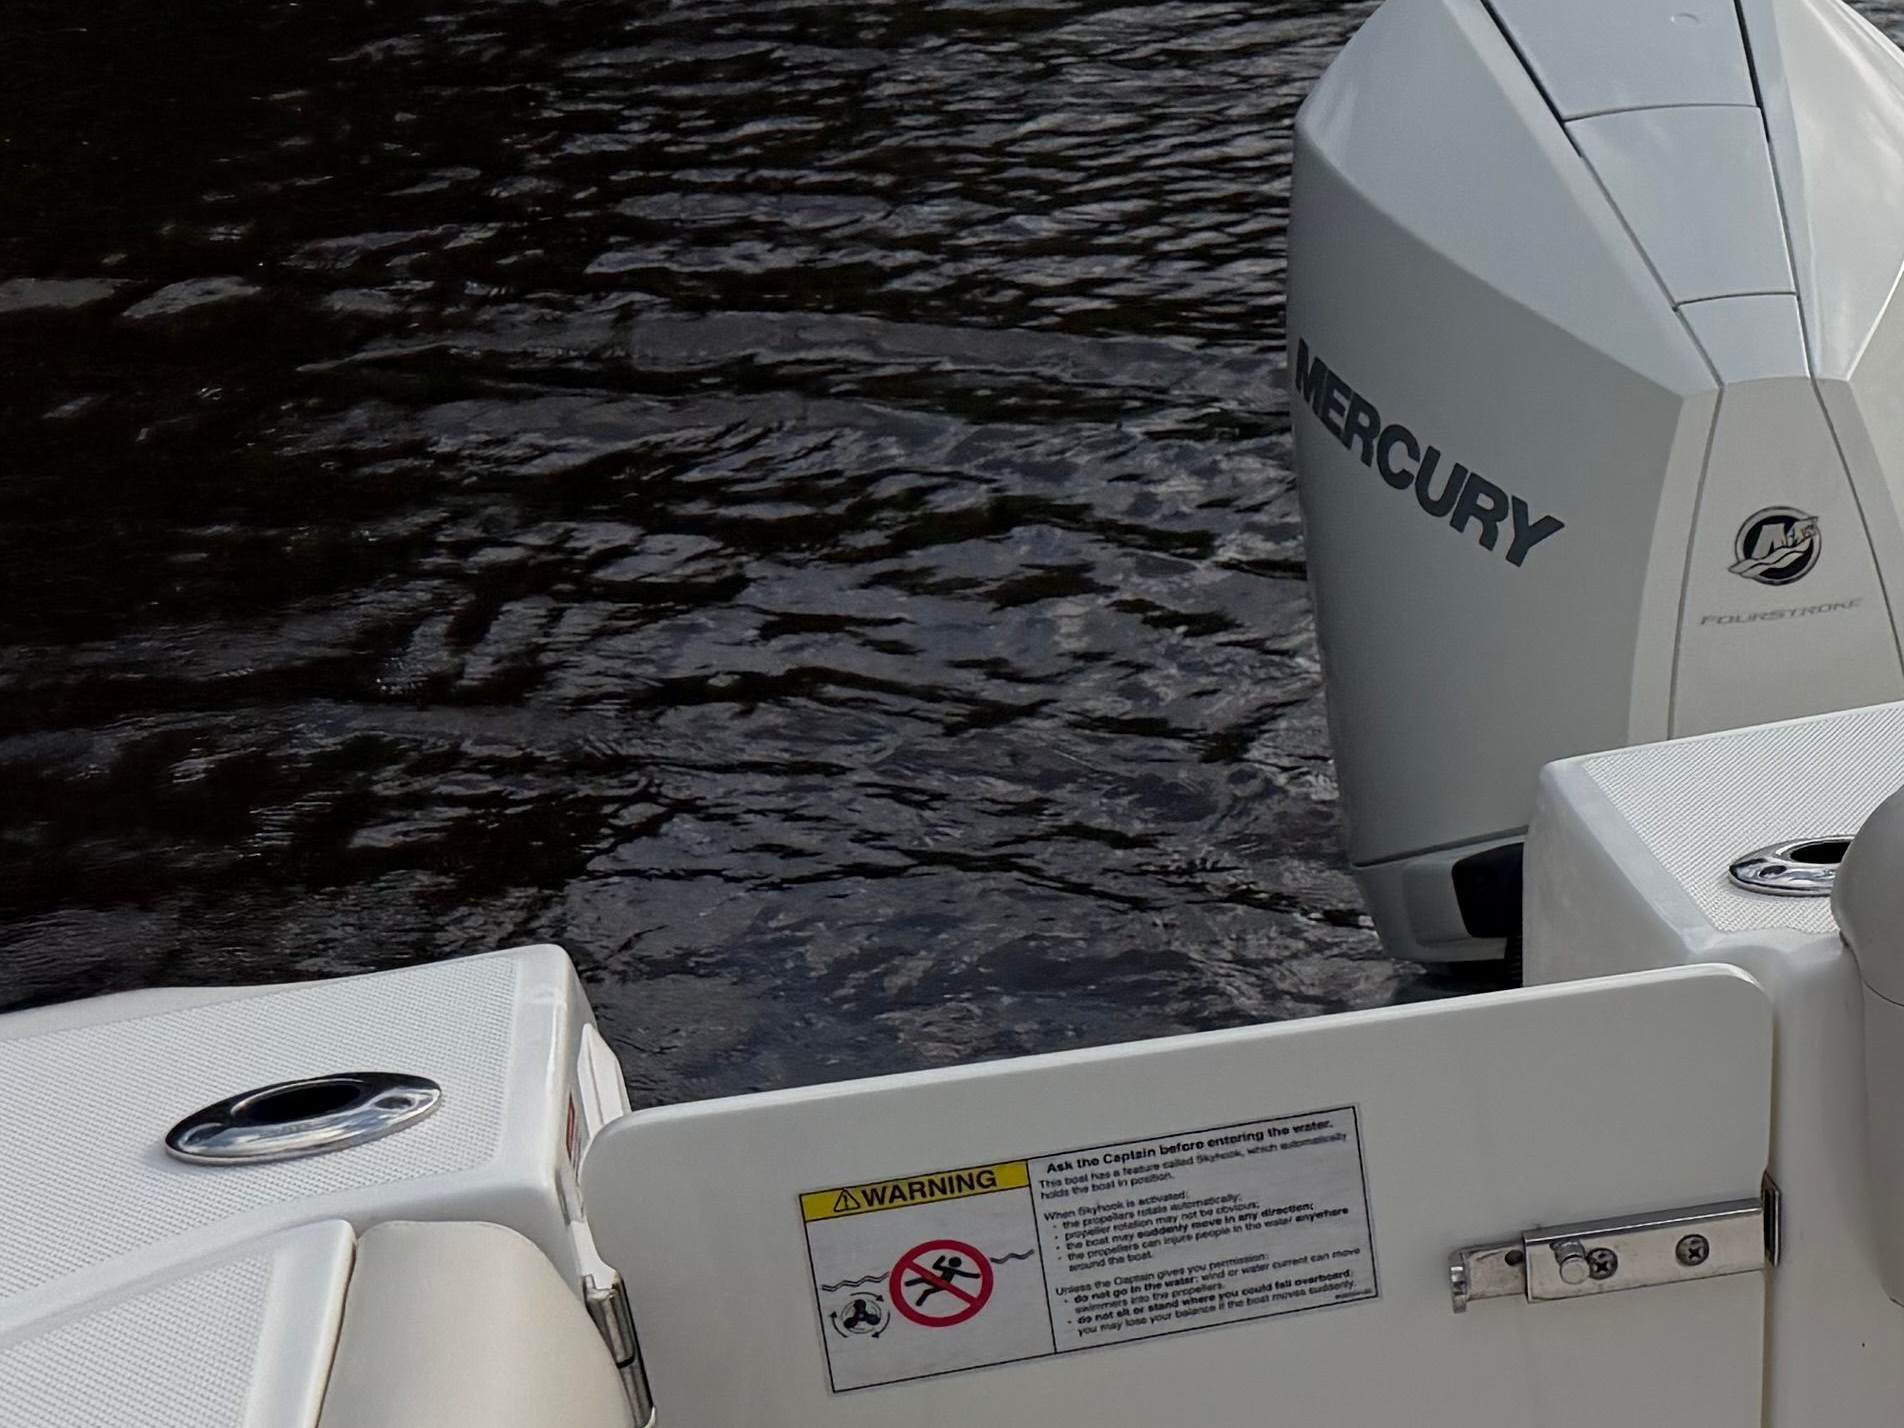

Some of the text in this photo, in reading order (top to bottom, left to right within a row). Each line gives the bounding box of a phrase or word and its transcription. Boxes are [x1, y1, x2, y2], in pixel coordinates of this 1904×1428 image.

[1295, 336, 1565, 568] MERCURY
[1047, 1161, 1073, 1174] Ask
[1076, 1158, 1100, 1169] the
[1103, 1148, 1156, 1164] Captain
[1159, 1141, 1204, 1155] before
[1207, 1131, 1264, 1148] entering
[1267, 1127, 1290, 1138] the
[861, 1169, 998, 1207] WARNING
[1072, 1186, 1089, 1195] the
